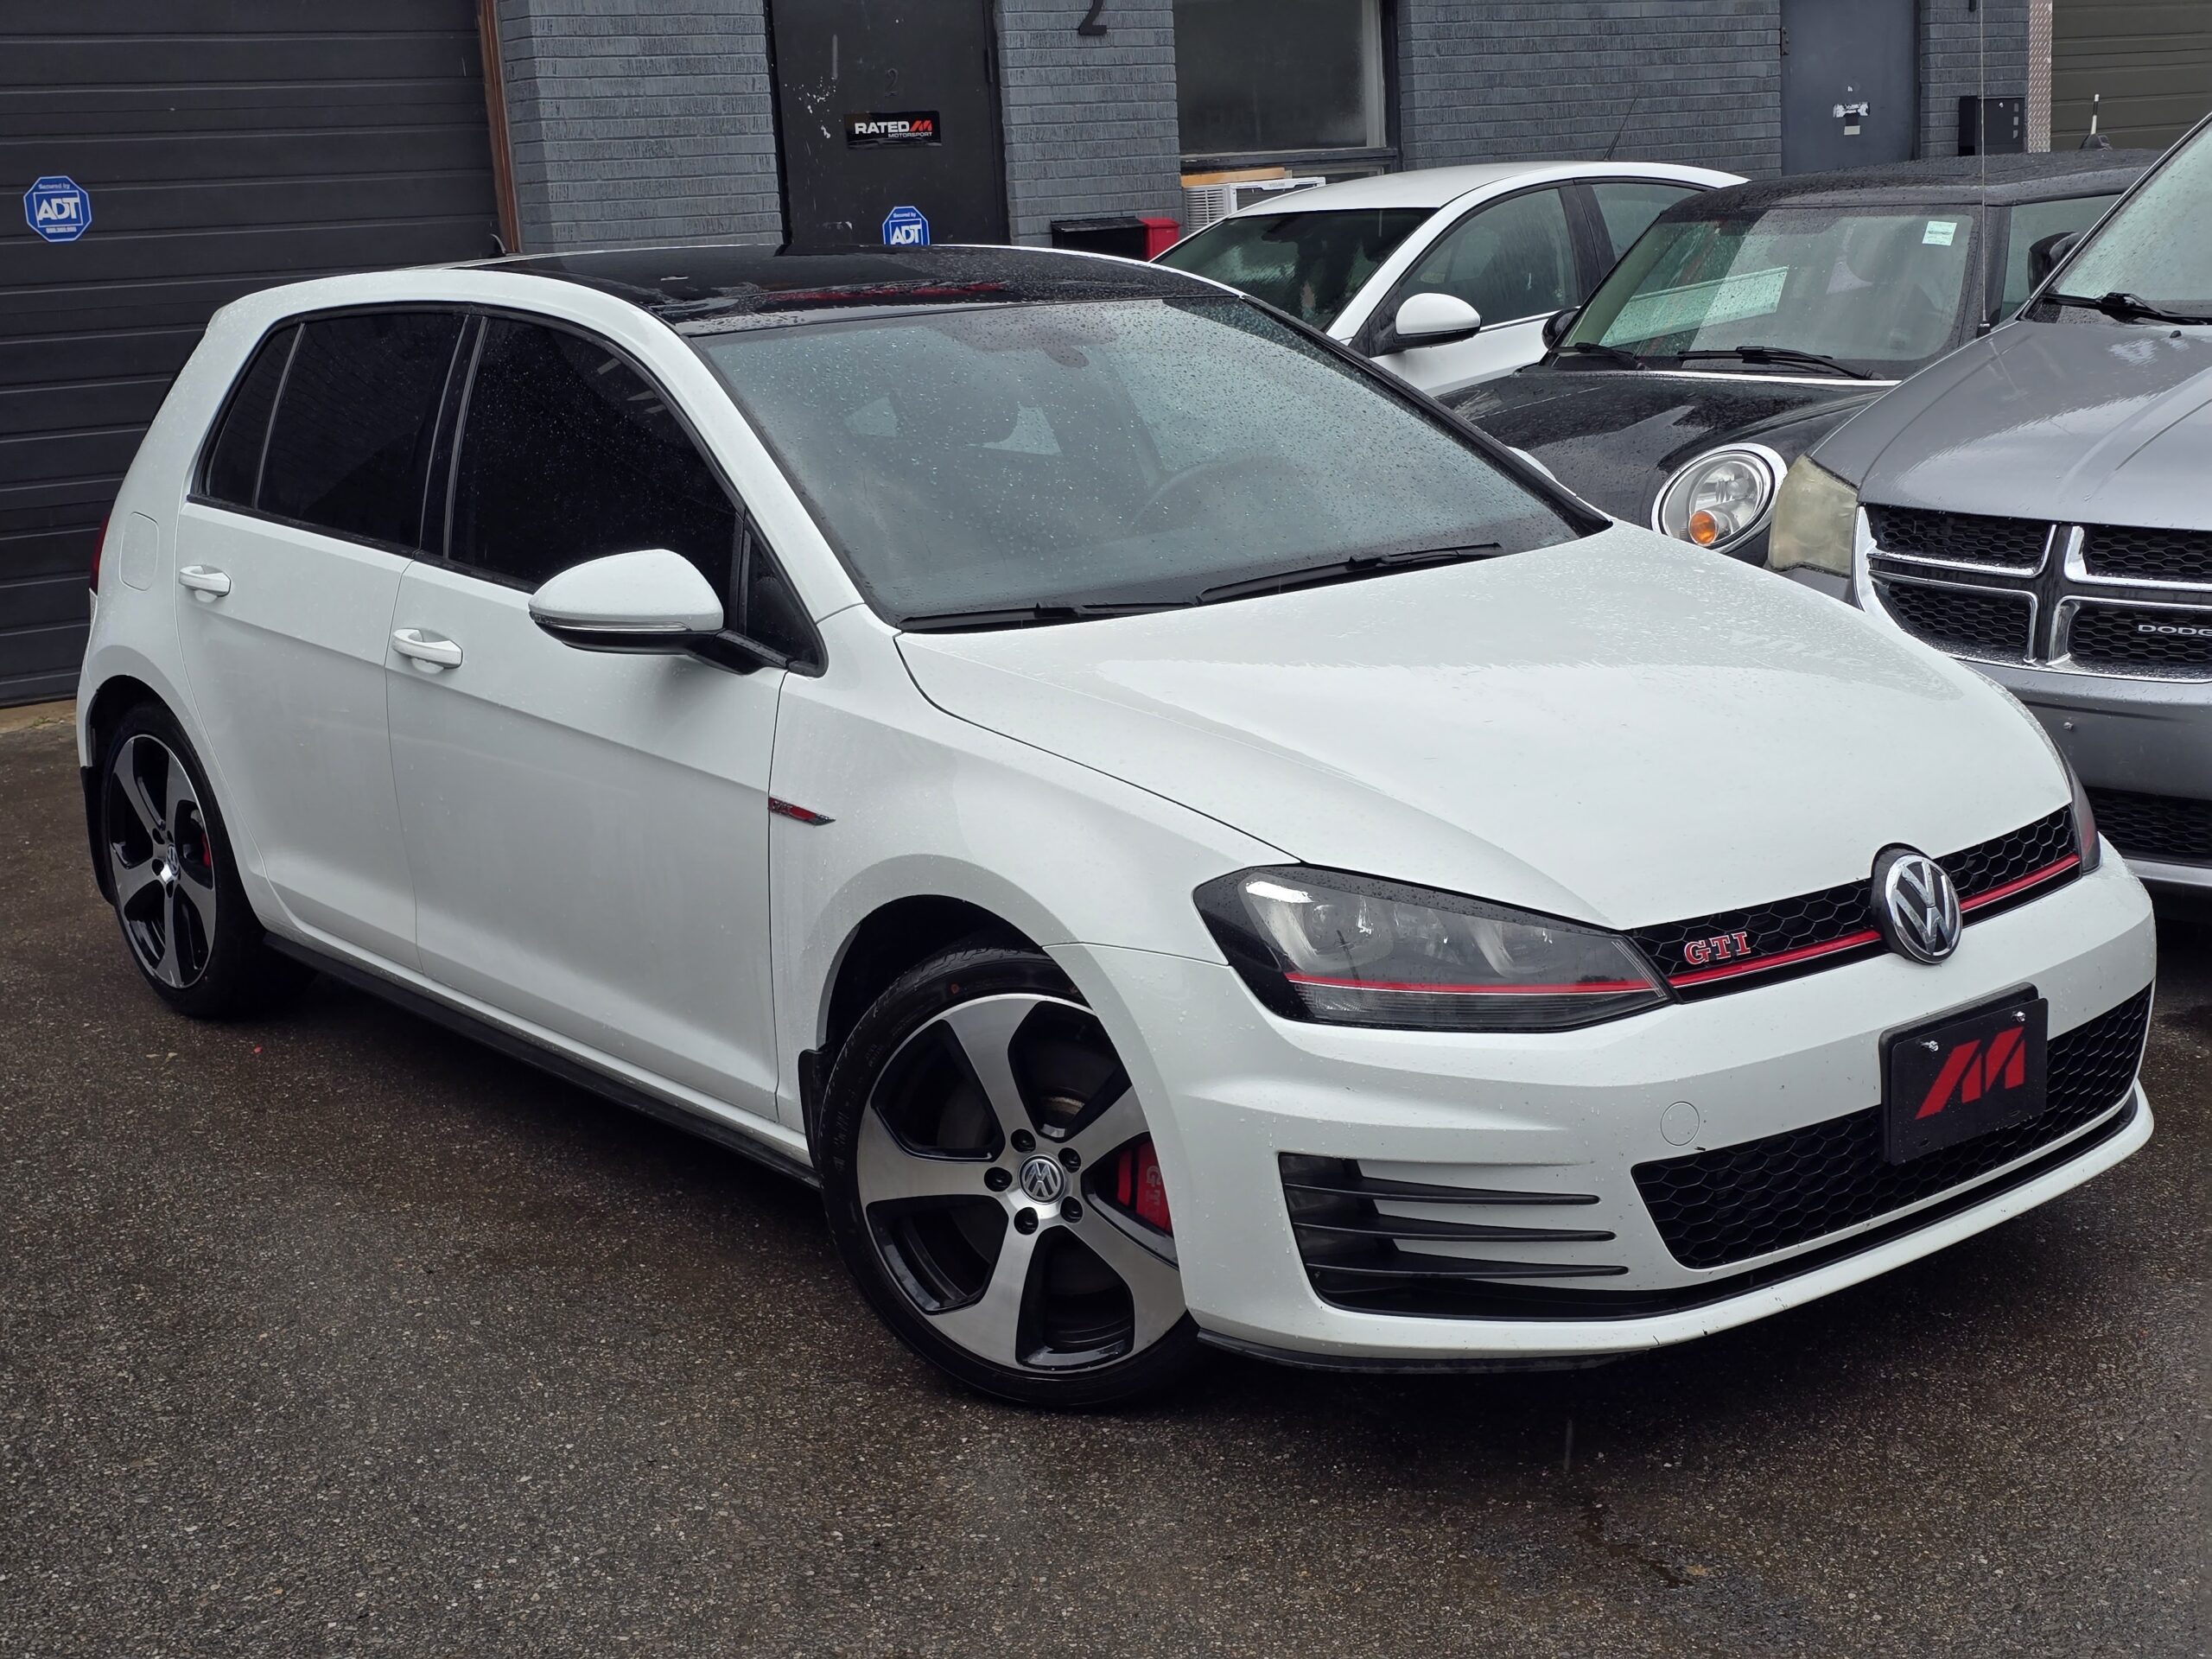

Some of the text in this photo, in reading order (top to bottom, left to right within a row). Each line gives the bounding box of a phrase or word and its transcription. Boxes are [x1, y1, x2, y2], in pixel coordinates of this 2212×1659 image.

[885, 68, 899, 97] 2
[855, 121, 910, 134] RATED
[37, 197, 79, 220] ADT
[891, 224, 922, 245] ADT
[1683, 931, 1751, 965] GTI
